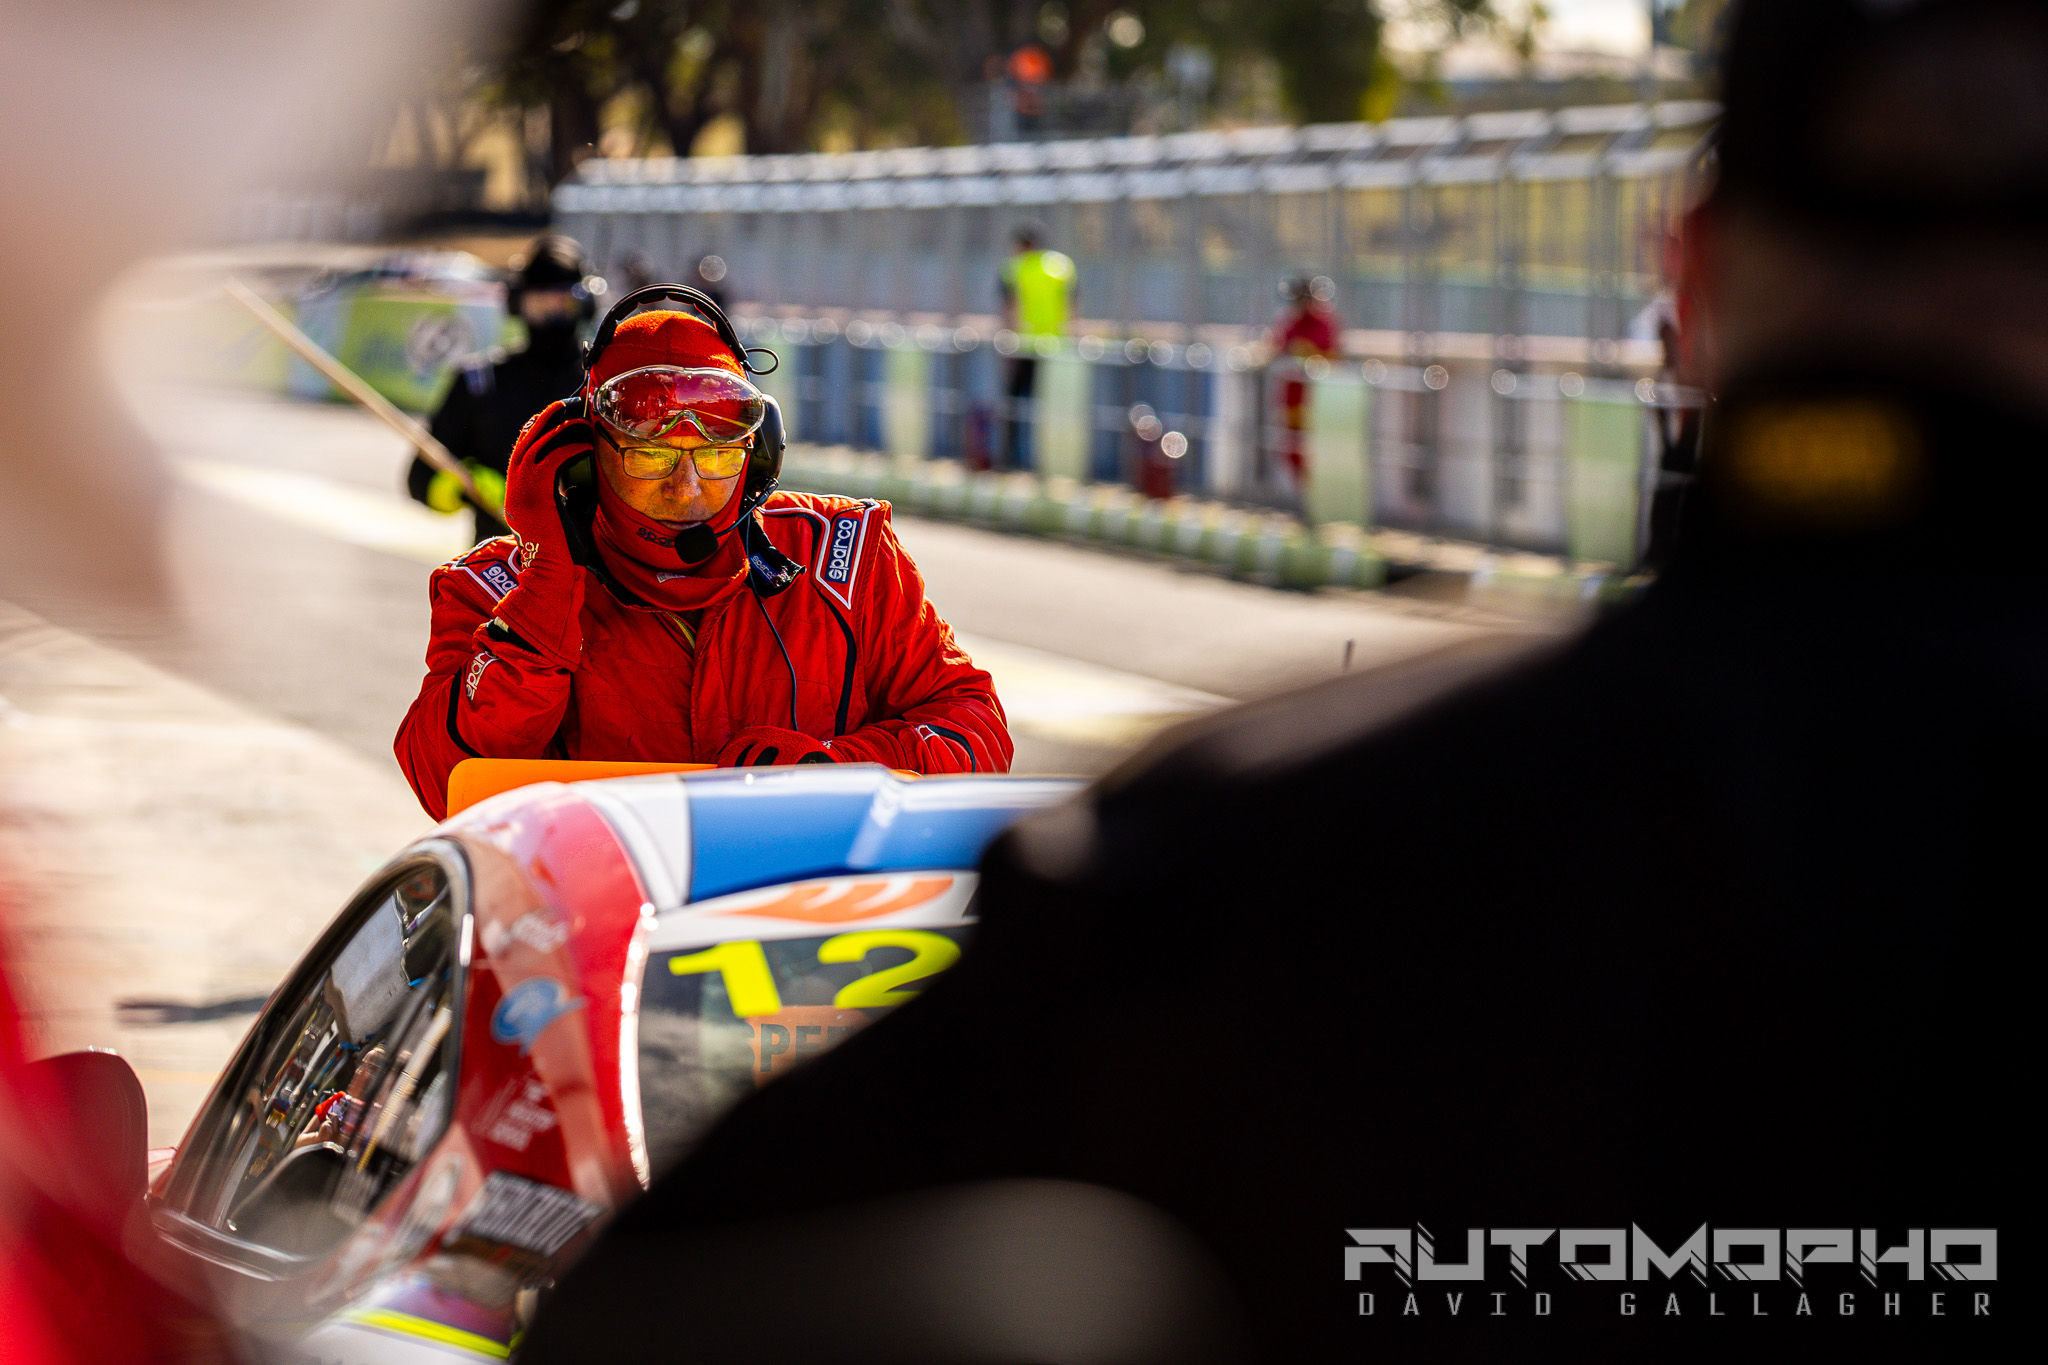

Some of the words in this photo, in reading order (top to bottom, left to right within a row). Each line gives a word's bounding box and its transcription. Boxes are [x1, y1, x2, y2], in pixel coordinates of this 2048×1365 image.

[636, 527, 676, 549] spar
[828, 519, 858, 582] sparco
[465, 651, 497, 701] spar
